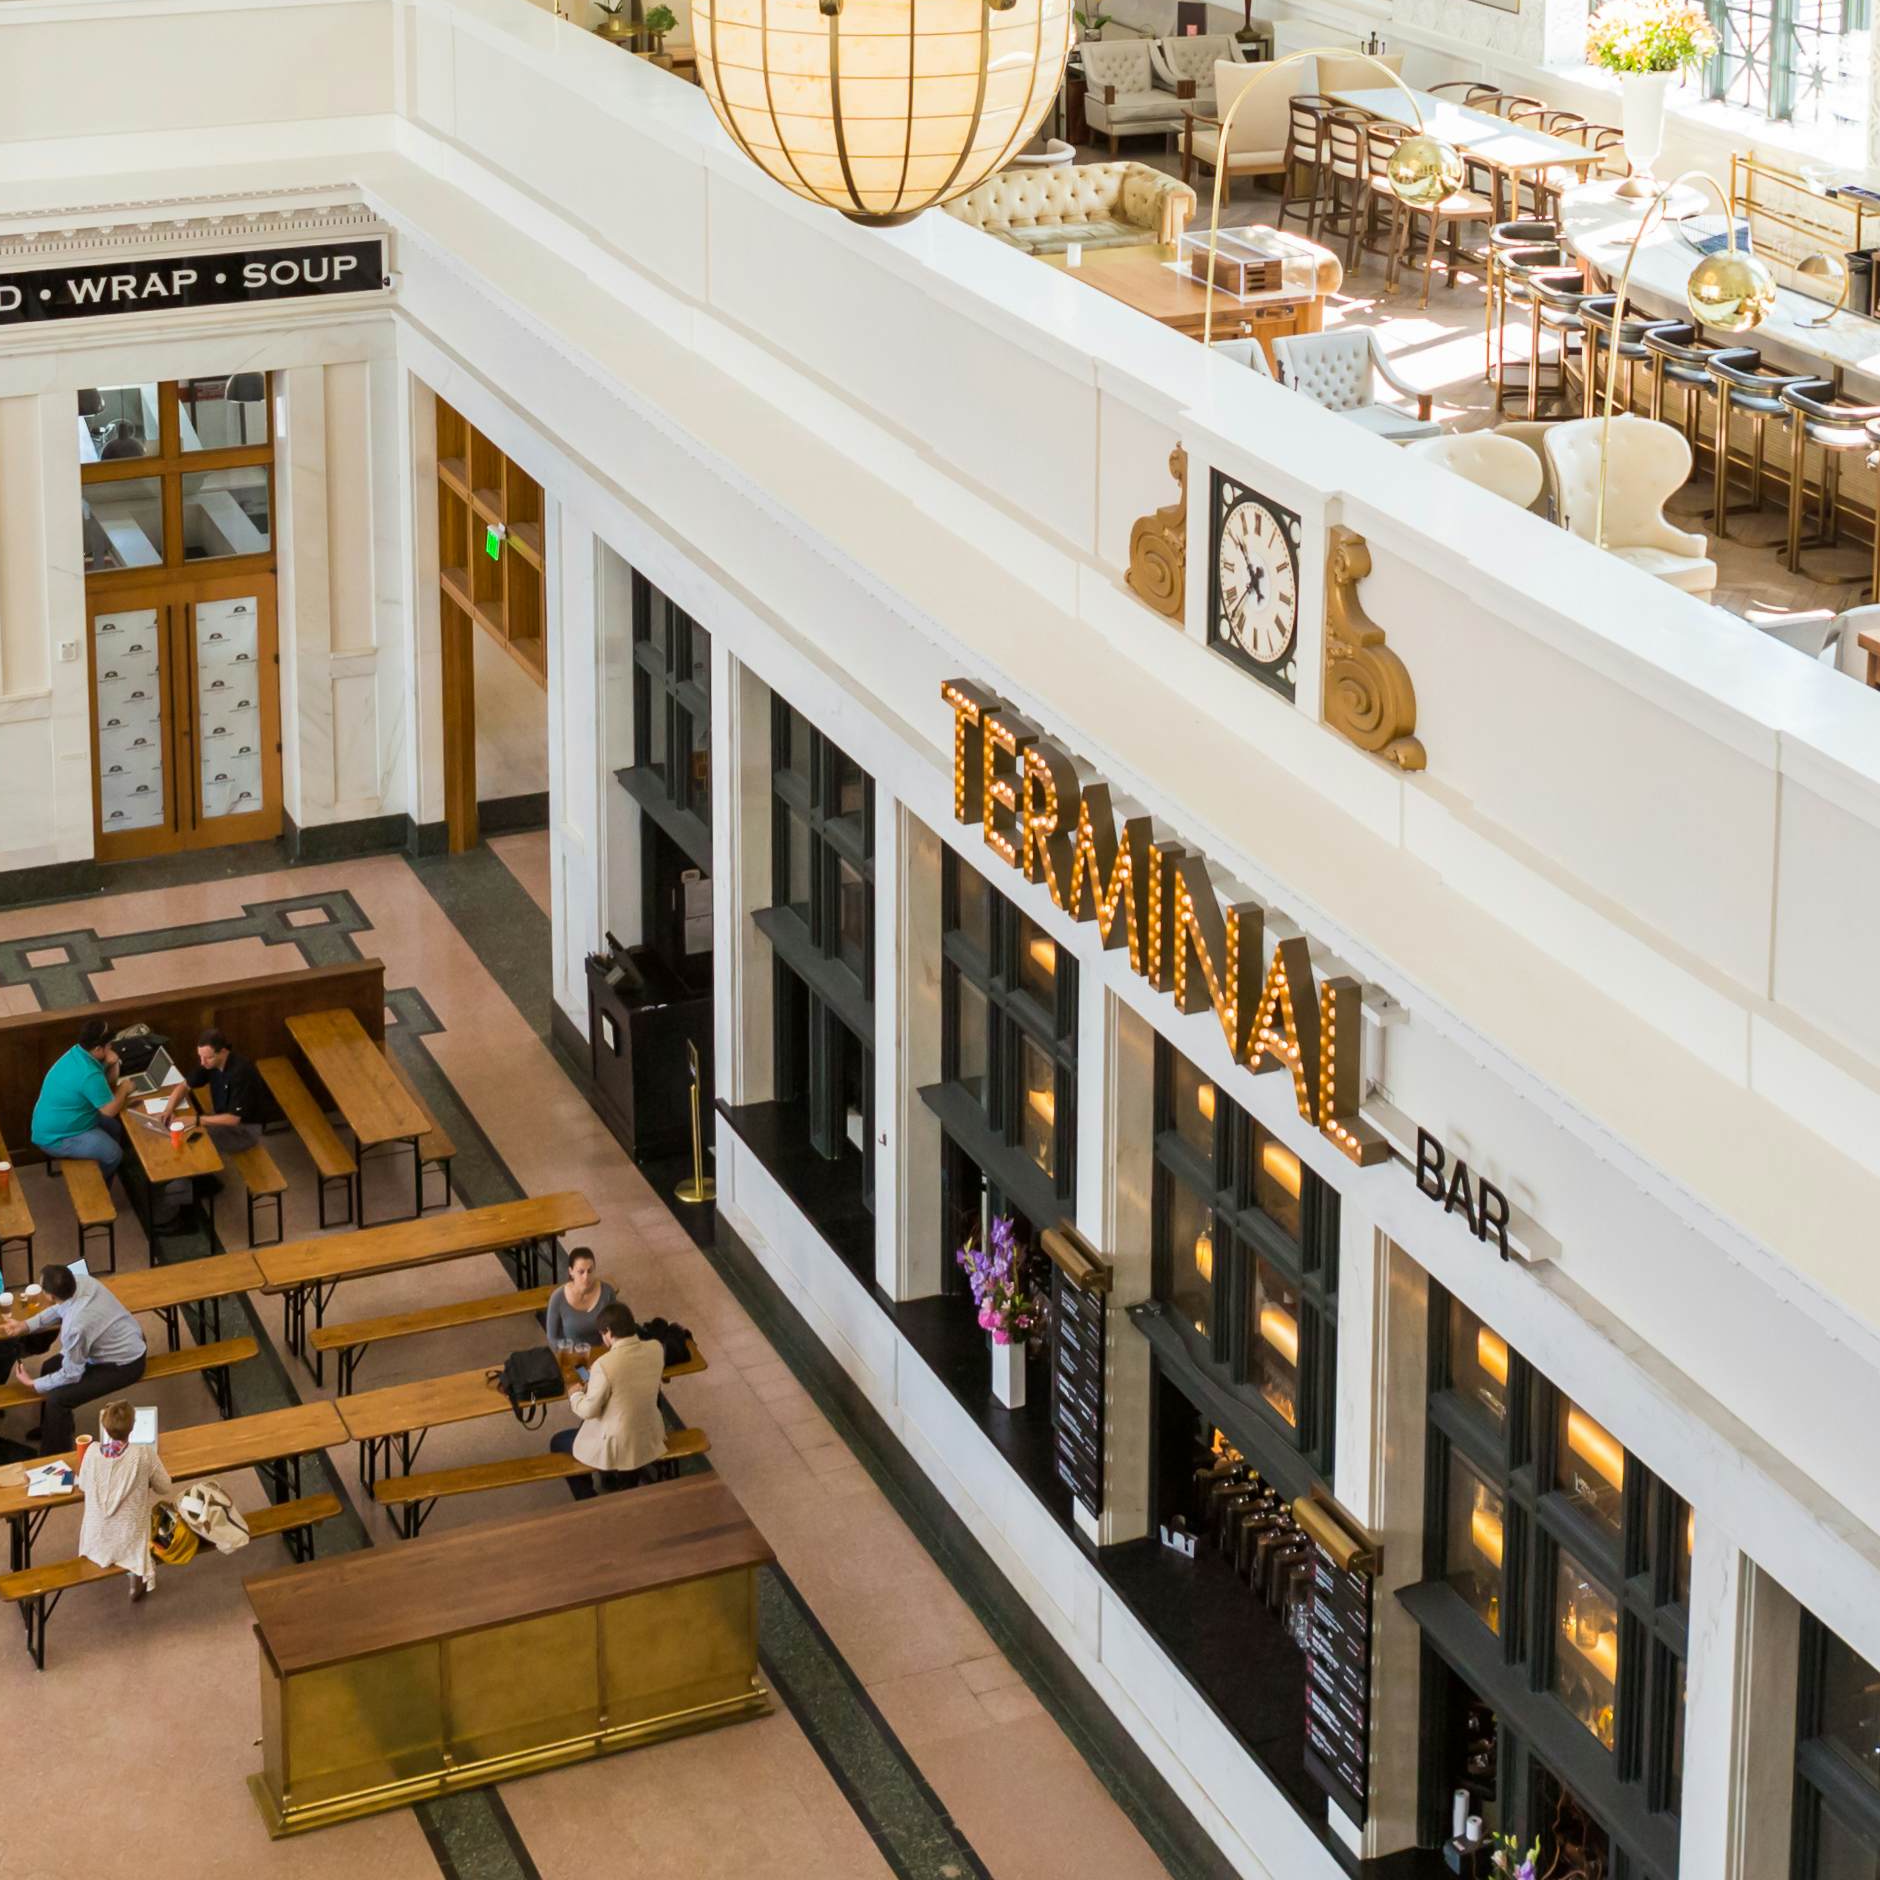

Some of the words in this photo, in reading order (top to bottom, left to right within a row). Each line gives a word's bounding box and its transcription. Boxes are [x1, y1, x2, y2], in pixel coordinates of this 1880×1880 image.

[66, 268, 200, 306] WRAP
[243, 256, 357, 287] SOUP
[940, 678, 1389, 1167] TERMINAL
[1415, 1126, 1510, 1261] BAR
